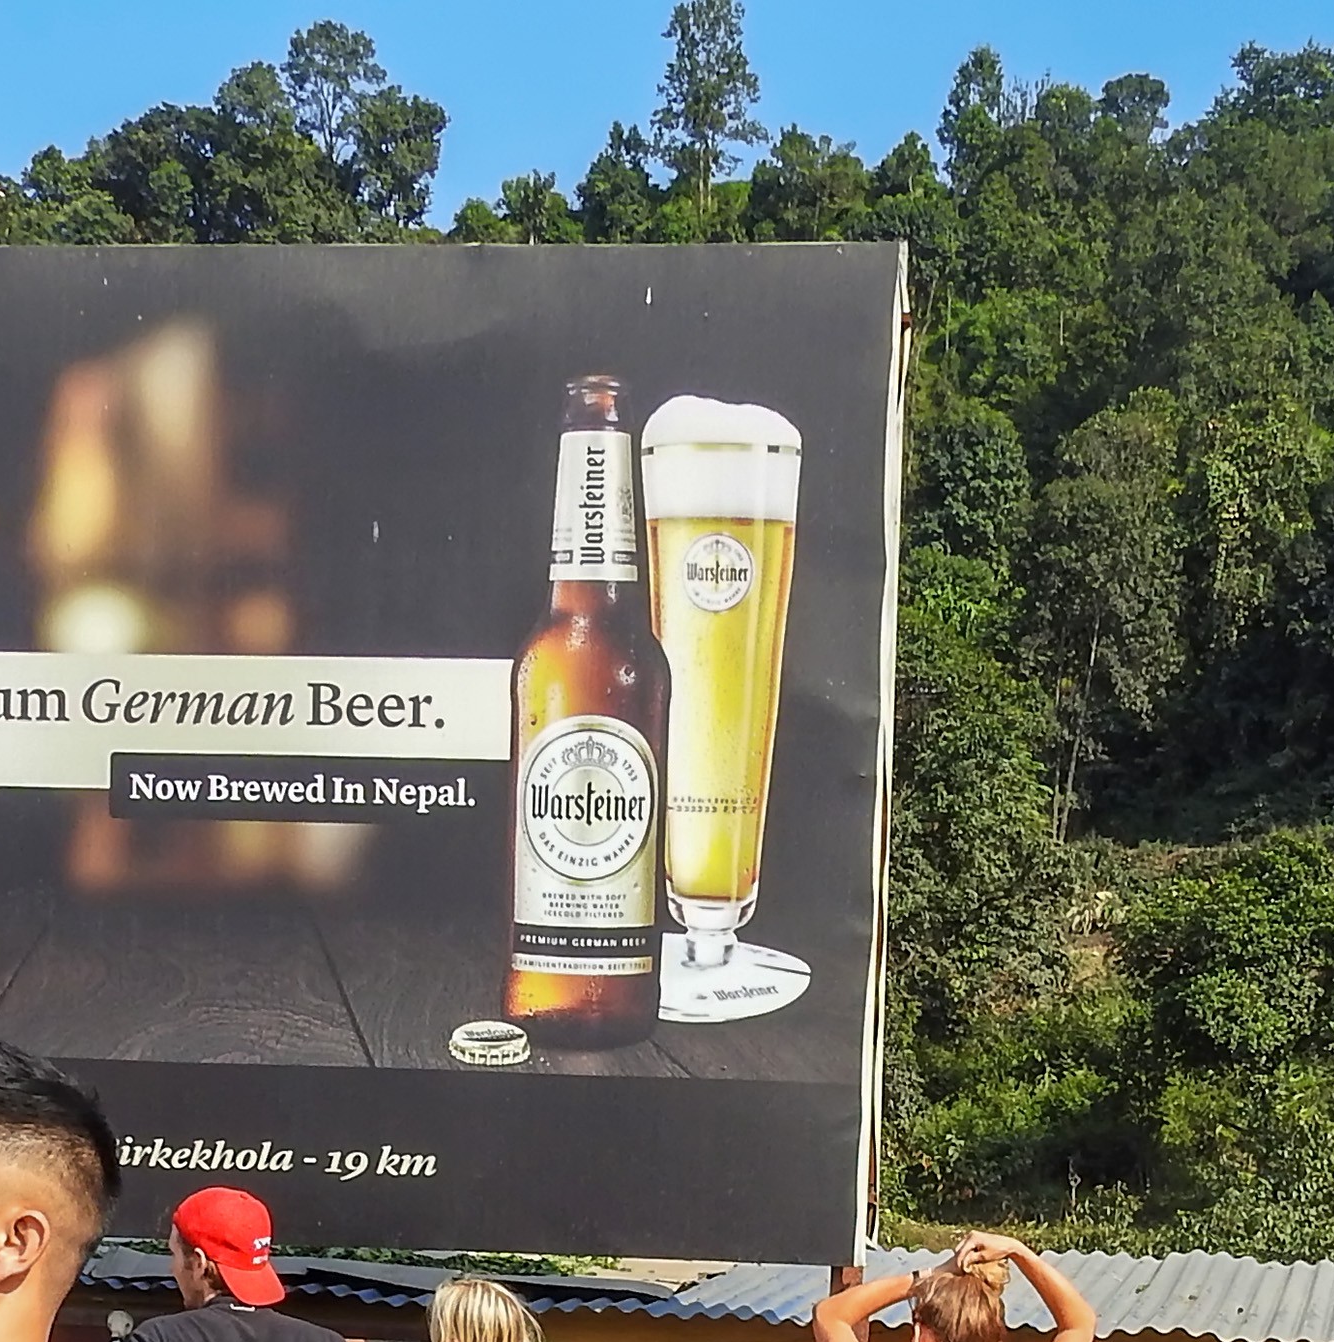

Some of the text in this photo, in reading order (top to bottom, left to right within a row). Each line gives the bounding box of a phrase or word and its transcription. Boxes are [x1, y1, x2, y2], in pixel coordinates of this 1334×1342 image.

[579, 446, 605, 565] Warsteiner
[687, 560, 748, 584] Warsteiner
[81, 678, 298, 726] German
[306, 681, 447, 730] Beer.
[129, 773, 477, 814] Now Brewed In Nepal.
[531, 781, 646, 826] Warsteiner
[539, 831, 635, 866] DAS EINZIG WAHRE
[520, 934, 567, 946] PREMIUM
[572, 937, 617, 947] GERMAN
[713, 985, 779, 1001] Warsteiner
[116, 1135, 293, 1173] irkekhola
[324, 1148, 369, 1182] 19
[376, 1144, 438, 1178] km
